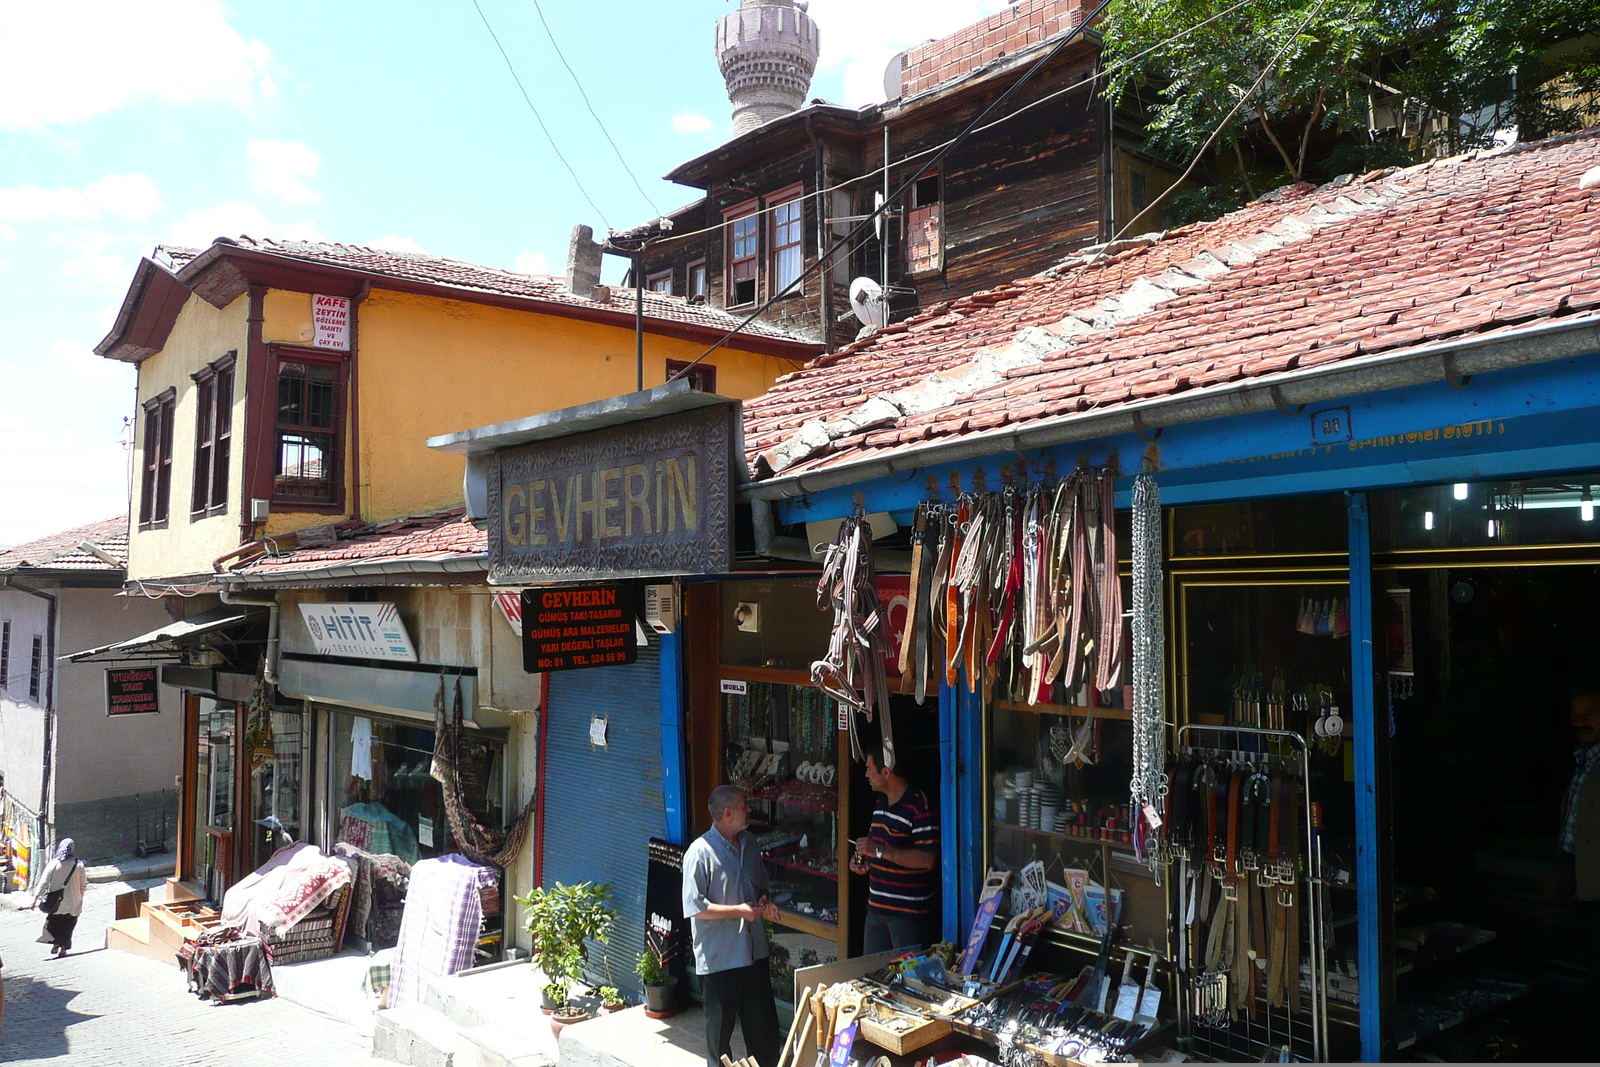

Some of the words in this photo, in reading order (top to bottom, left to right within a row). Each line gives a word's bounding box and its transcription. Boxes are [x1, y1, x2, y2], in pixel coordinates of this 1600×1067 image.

[316, 297, 346, 308] KAFE
[316, 308, 346, 318] ZEYTİN
[316, 318, 346, 326] GÖZLEME
[319, 325, 342, 333] MANTI
[504, 457, 697, 546] GEVHERİN
[542, 588, 616, 608] GEVHERİN
[538, 611, 568, 624] GÜMÜŞ
[569, 609, 622, 621] TAKI-TASARIM
[320, 606, 376, 642] HİTİT
[531, 626, 561, 640] GÜMÜŞ
[562, 627, 579, 637] ARA
[580, 623, 630, 636] MALZEMELER
[333, 643, 368, 655] TEKSTİL
[371, 646, 386, 656] LTD
[541, 643, 560, 654] YARI
[561, 637, 594, 652] DEĞERLİ
[595, 637, 624, 651] TAŞLAR
[538, 658, 553, 668] NO:
[554, 657, 564, 667] 81
[572, 655, 589, 665] TEL.
[591, 654, 605, 664] 324
[606, 653, 616, 662] 56
[617, 652, 626, 661] 99
[112, 670, 154, 682] TUĞRA
[122, 682, 144, 691] TAKI
[722, 683, 745, 692] WORLD
[112, 693, 153, 704] TASARIM
